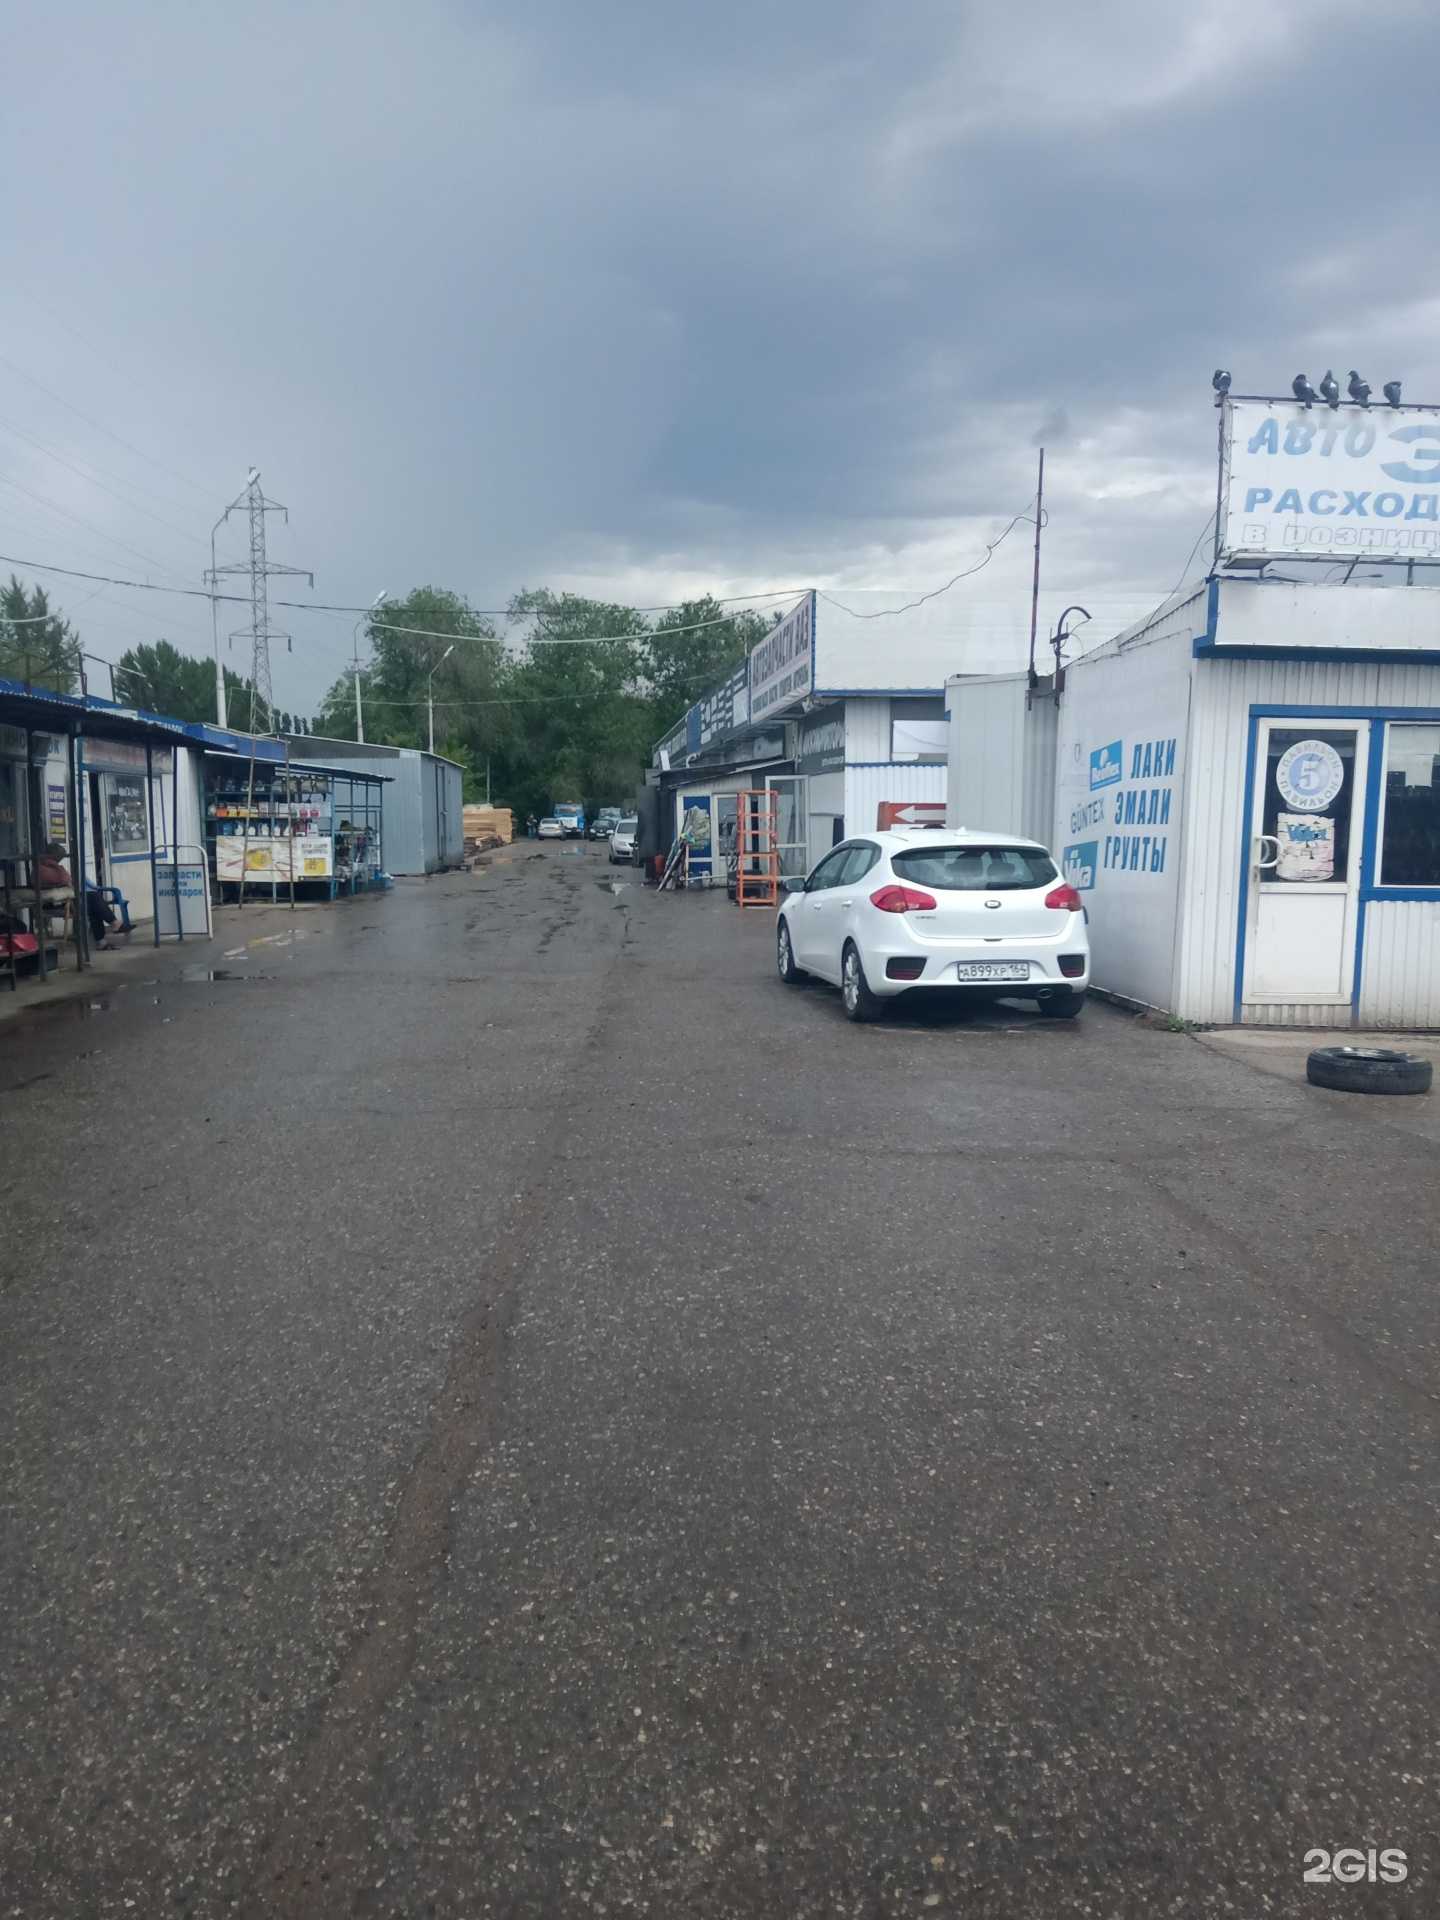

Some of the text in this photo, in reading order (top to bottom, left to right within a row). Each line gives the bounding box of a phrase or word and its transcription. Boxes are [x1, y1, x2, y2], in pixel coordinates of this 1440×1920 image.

[1244, 487, 1440, 522] РАСХОД
[1130, 738, 1177, 779] ЛАКИ
[1298, 760, 1321, 791] 5
[1070, 797, 1105, 835] GÜNTEX
[1114, 788, 1172, 825] ЭМАЛИ
[1104, 835, 1168, 873] ГРУНТЫ
[157, 871, 202, 880] запасти
